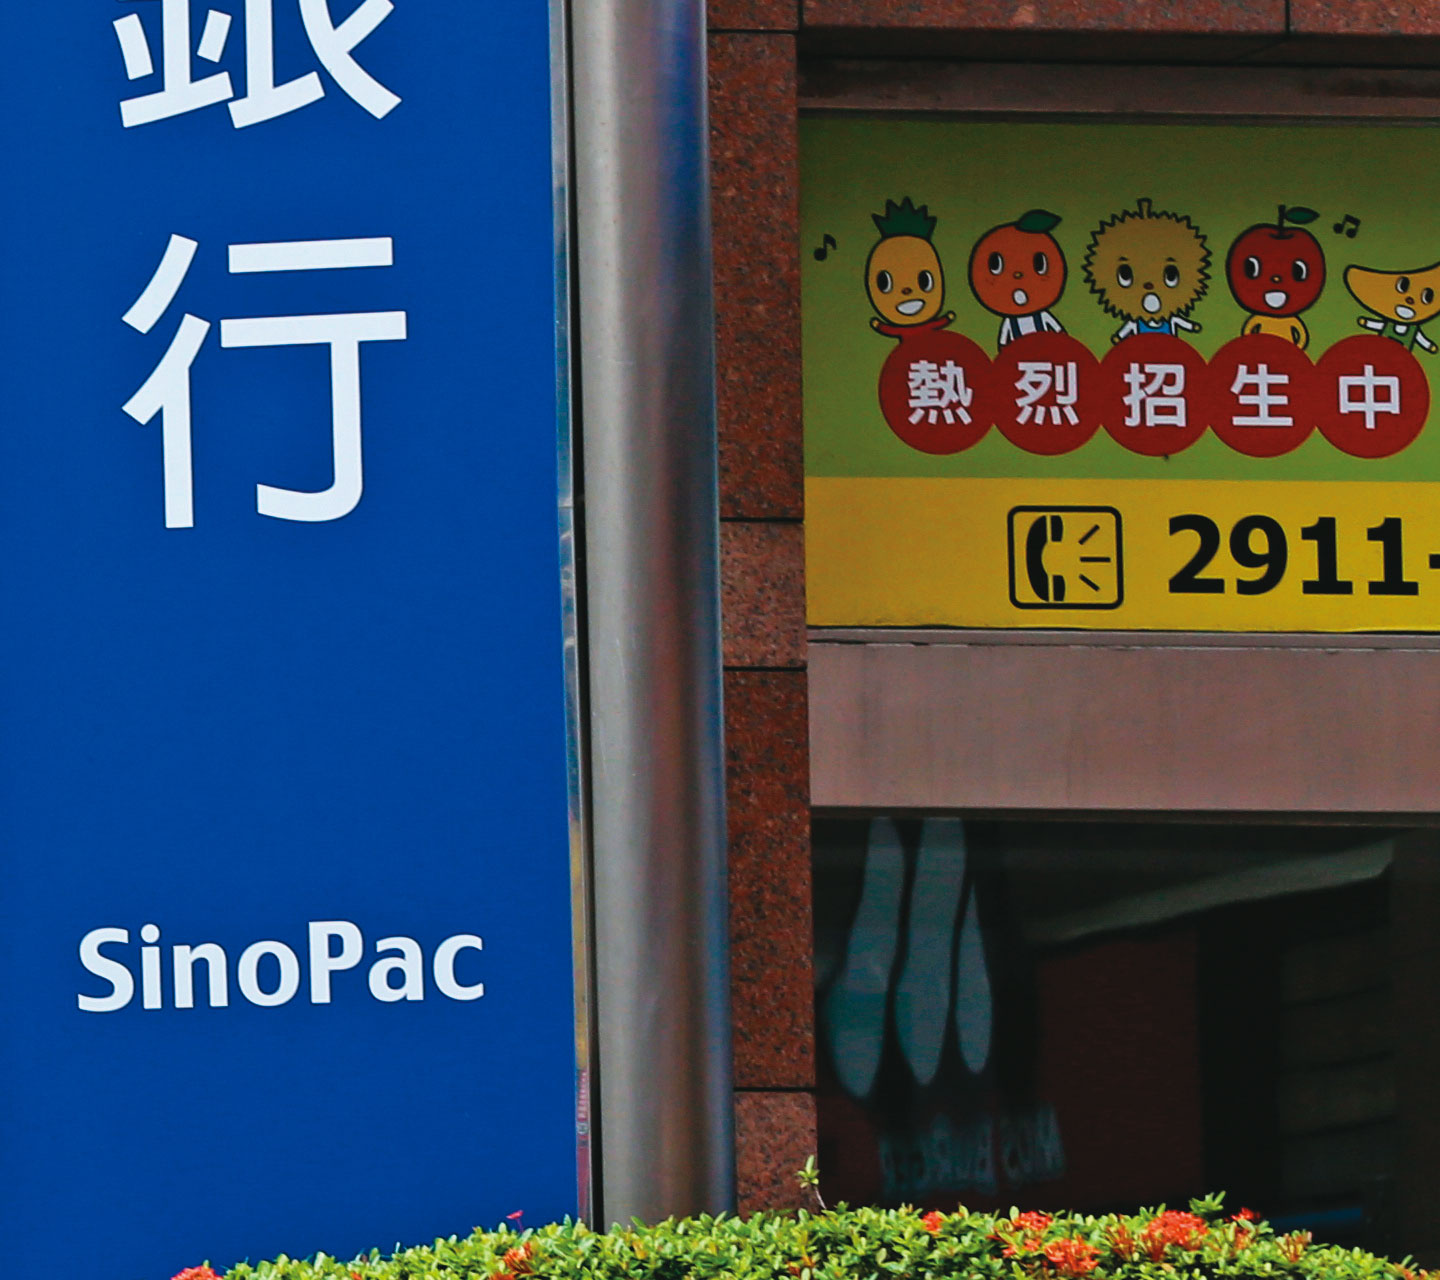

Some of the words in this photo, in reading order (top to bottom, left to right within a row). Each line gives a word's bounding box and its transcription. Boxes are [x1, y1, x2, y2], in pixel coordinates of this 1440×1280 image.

[907, 360, 1400, 430] 熱烈招生中
[77, 920, 485, 1013] SinoPac
